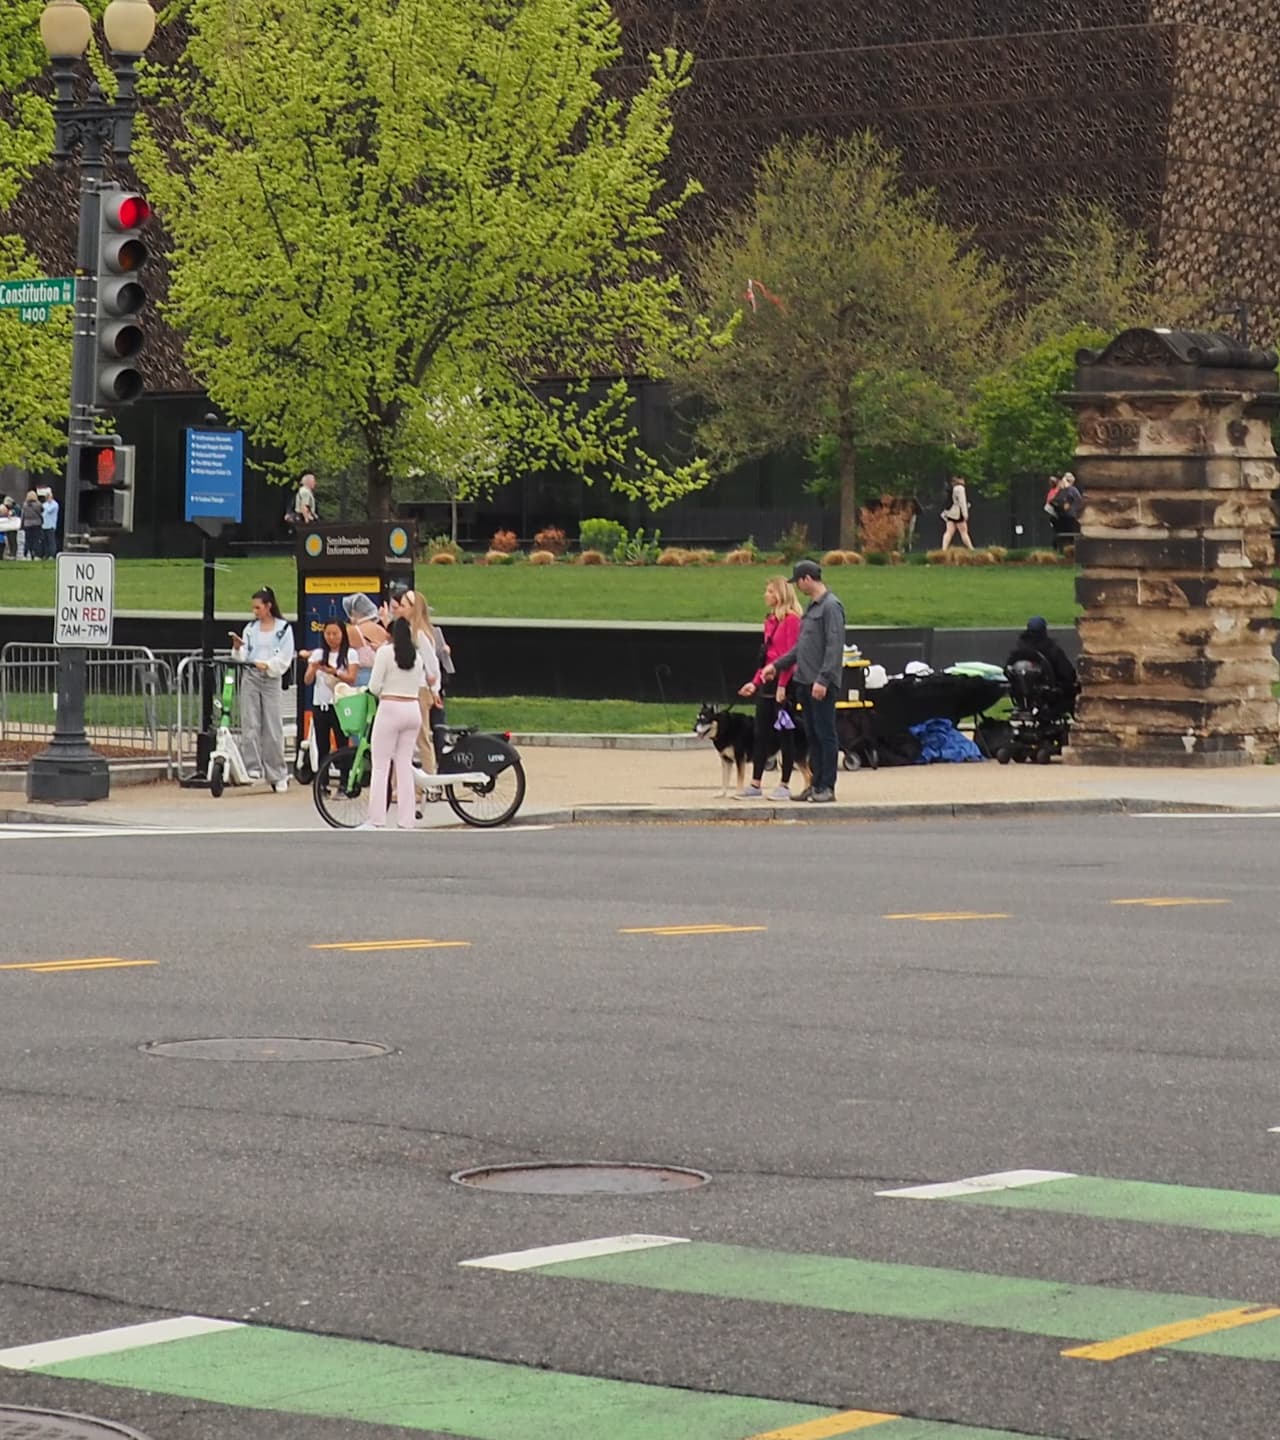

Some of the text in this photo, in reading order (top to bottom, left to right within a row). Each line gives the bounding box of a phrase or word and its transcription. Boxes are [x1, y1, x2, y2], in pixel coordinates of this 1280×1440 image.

[0, 283, 60, 305] Constitution
[22, 307, 46, 322] 1400
[326, 536, 370, 545] Smithsonian
[326, 545, 369, 555] Information
[76, 563, 95, 580] NO
[67, 585, 104, 602] TURN
[61, 606, 106, 622] ON RED
[60, 624, 107, 636] 7AM-7PM
